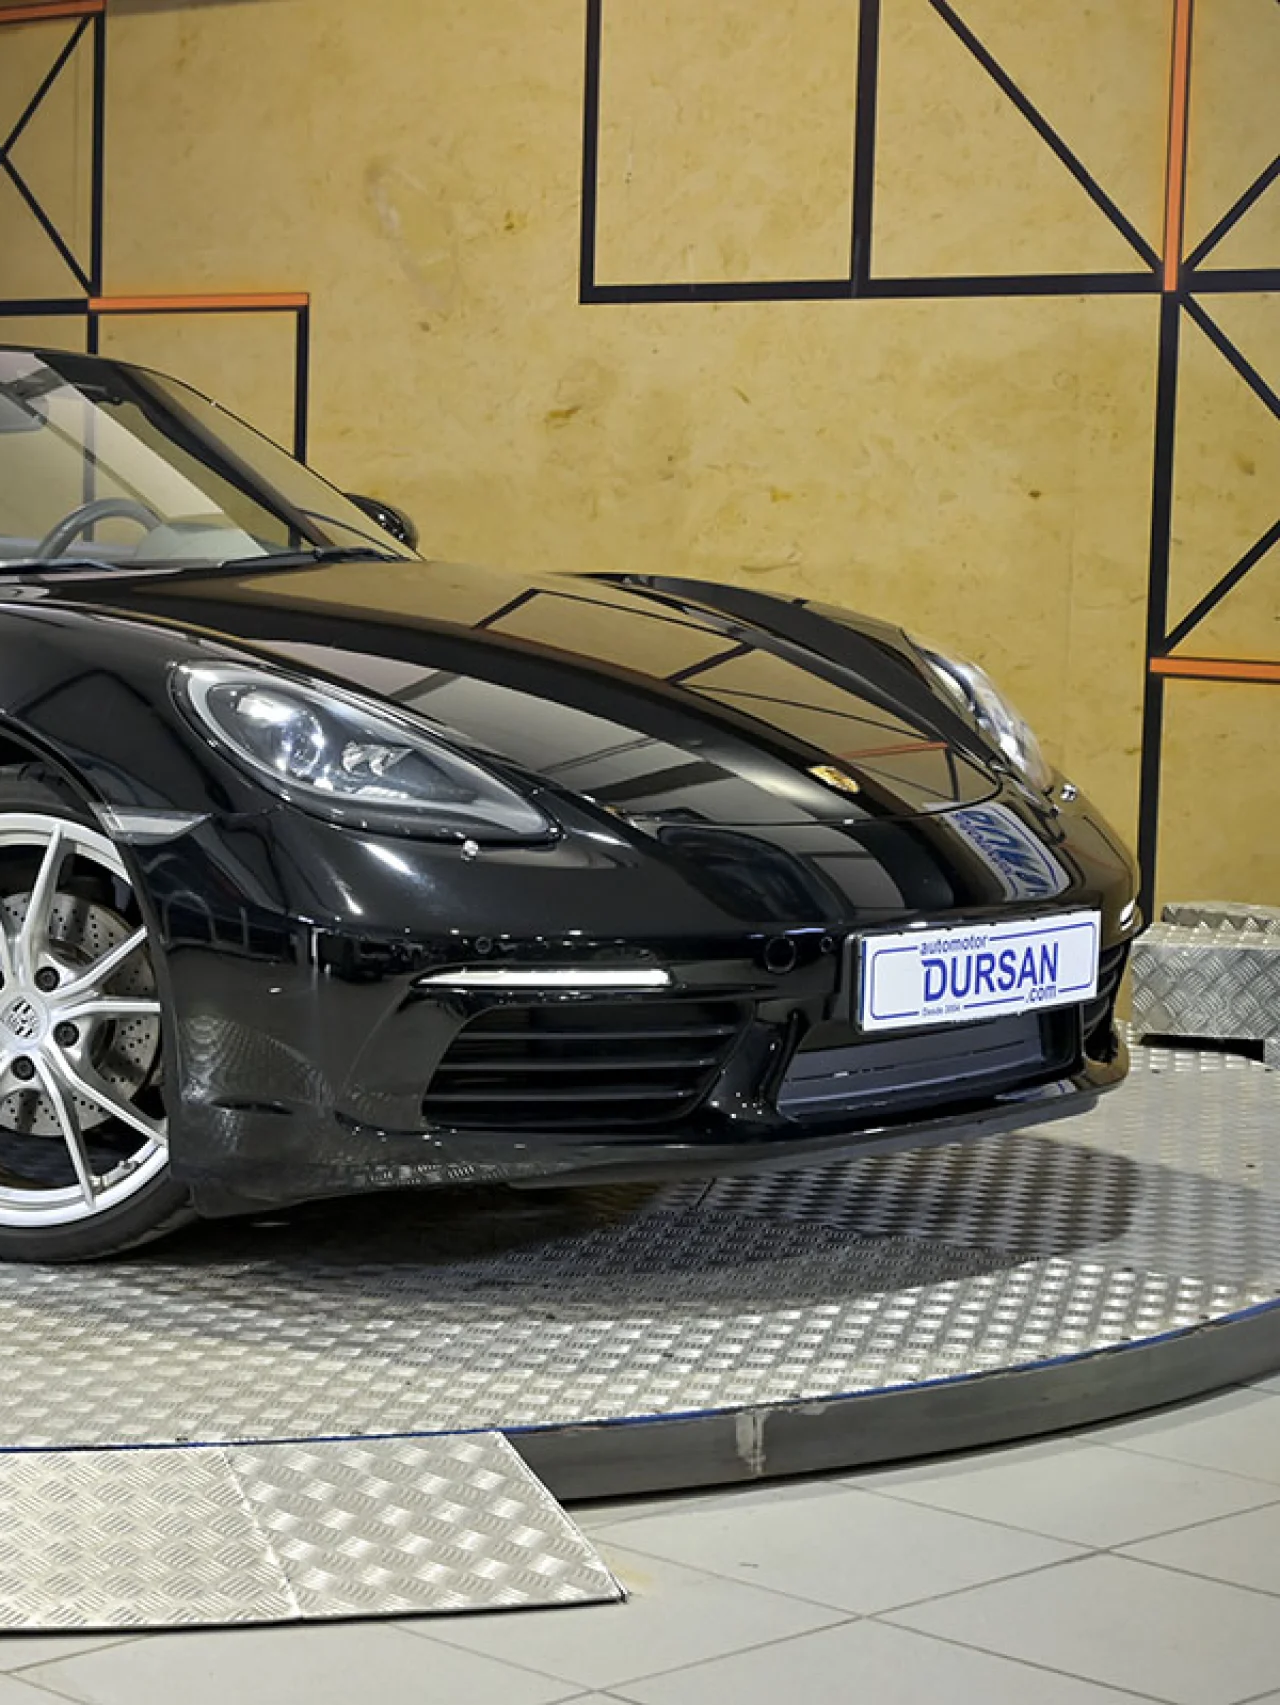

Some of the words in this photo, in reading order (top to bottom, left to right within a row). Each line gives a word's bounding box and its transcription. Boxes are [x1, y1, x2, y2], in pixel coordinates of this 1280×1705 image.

[920, 934, 988, 956] automotor
[921, 941, 1058, 1002] DURSAN
[1025, 985, 1057, 1003] .com
